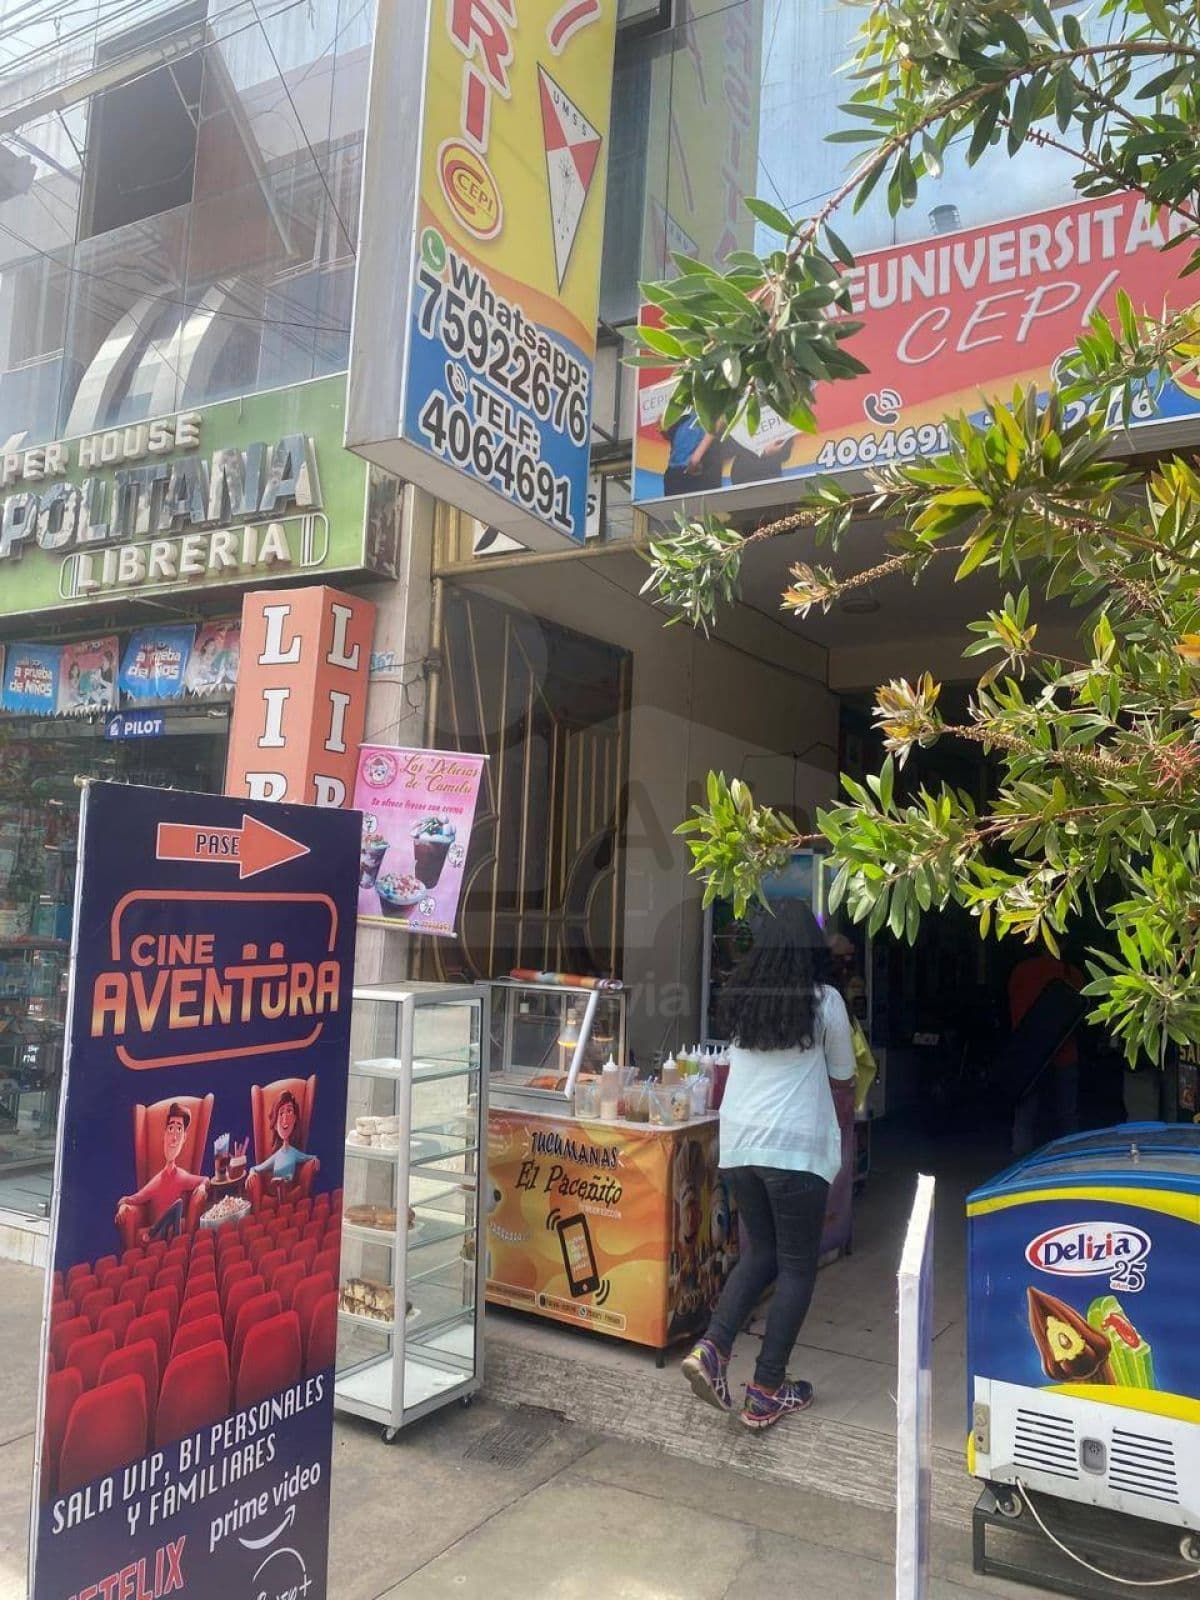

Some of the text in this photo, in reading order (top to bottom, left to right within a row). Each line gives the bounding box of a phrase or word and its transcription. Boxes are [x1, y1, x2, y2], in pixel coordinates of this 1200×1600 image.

[824, 196, 1200, 319] EUNIVERSITA
[449, 252, 588, 392] Whatsapp:
[897, 268, 1122, 365] CEPI
[419, 268, 586, 443] 75922676
[78, 411, 202, 468] HOUSE
[472, 382, 539, 454] TELF:
[756, 413, 782, 437] EPI
[817, 422, 949, 469] 4064691
[0, 431, 324, 561] POLITANA
[421, 395, 572, 530] 4064691
[77, 522, 293, 597] LIBRERIA
[124, 718, 163, 737] PILOT
[195, 832, 241, 856] PASE
[130, 933, 216, 967] CINE
[90, 959, 341, 1038] AVENTURA
[514, 1159, 624, 1207] El Paceñito
[530, 1131, 618, 1168] TUCUMANAS
[1044, 1232, 1131, 1266] Delizia
[1111, 1260, 1147, 1291] 25
[52, 1476, 114, 1535] SALA
[179, 1433, 202, 1473] BI
[209, 1374, 325, 1456] PERSONALES
[126, 1432, 277, 1536] Y FAMILIARES
[209, 1462, 321, 1554] prime video
[66, 1534, 187, 1600] TFLIX
